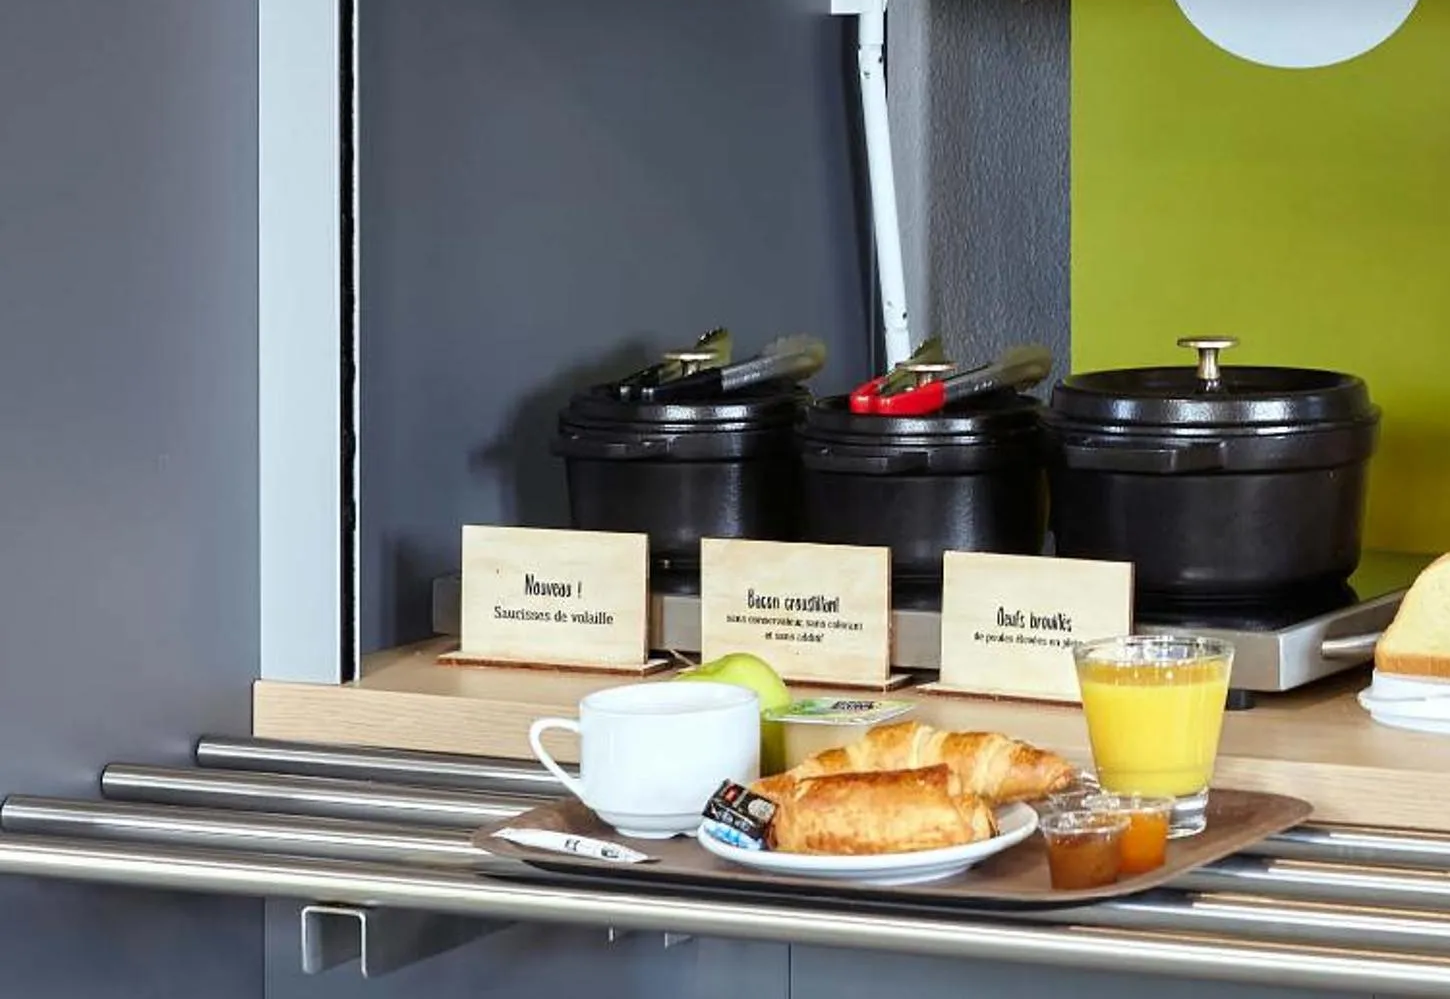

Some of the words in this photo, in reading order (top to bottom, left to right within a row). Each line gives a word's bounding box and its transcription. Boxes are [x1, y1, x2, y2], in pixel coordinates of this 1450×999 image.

[747, 588, 781, 610] Bacon
[494, 606, 552, 621] Saucisses
[554, 611, 568, 623] de
[571, 611, 614, 625] volaille
